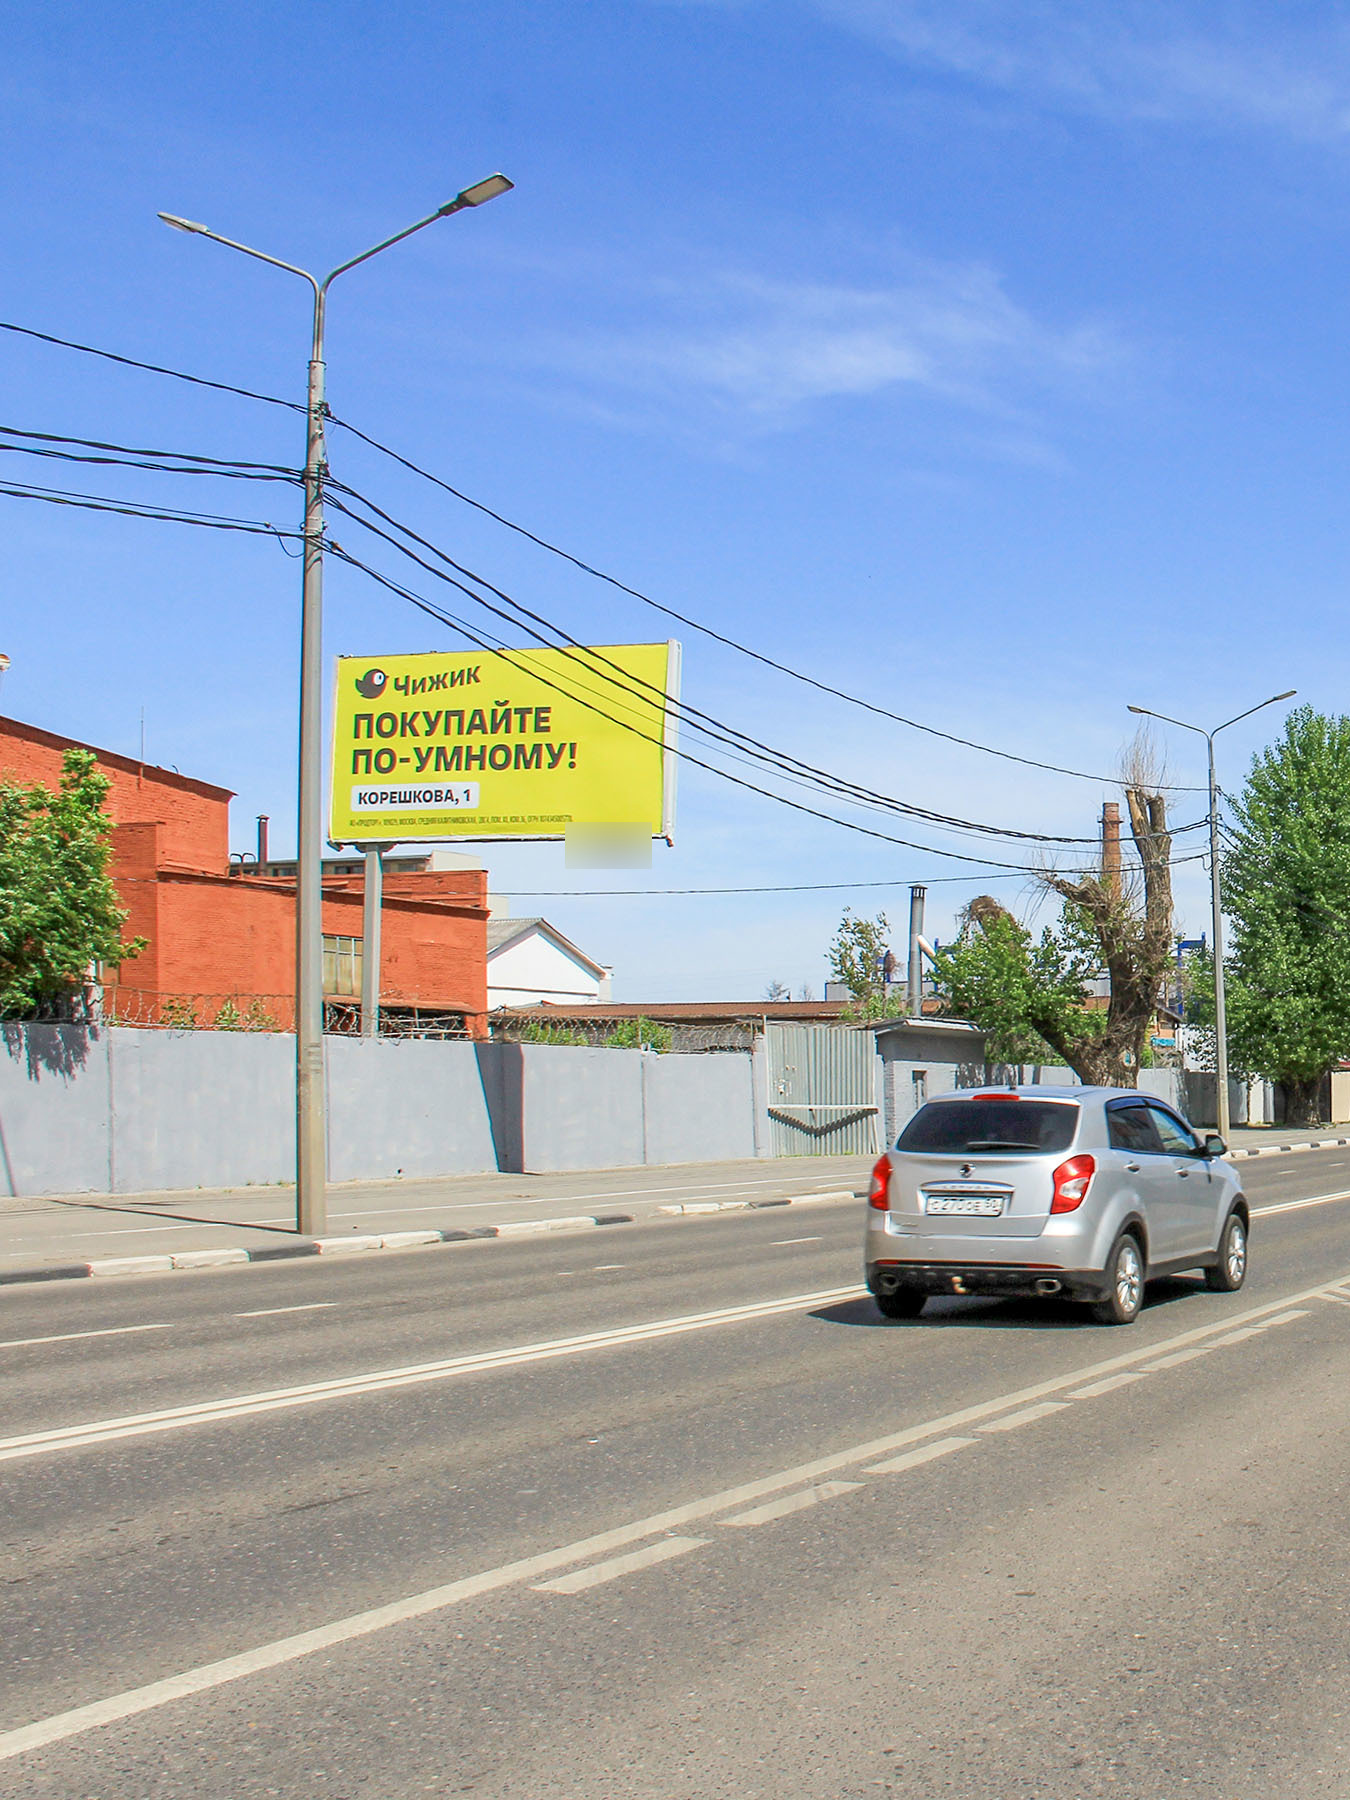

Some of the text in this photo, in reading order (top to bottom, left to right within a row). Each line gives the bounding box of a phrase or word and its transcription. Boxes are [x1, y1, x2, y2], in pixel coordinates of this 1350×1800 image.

[394, 666, 480, 696] Чижик
[353, 700, 551, 739] ПОКУПАЙТЕ
[352, 742, 577, 775] ПО-УМНОМУ!
[358, 789, 471, 806] КОРЕШКОВА, 1
